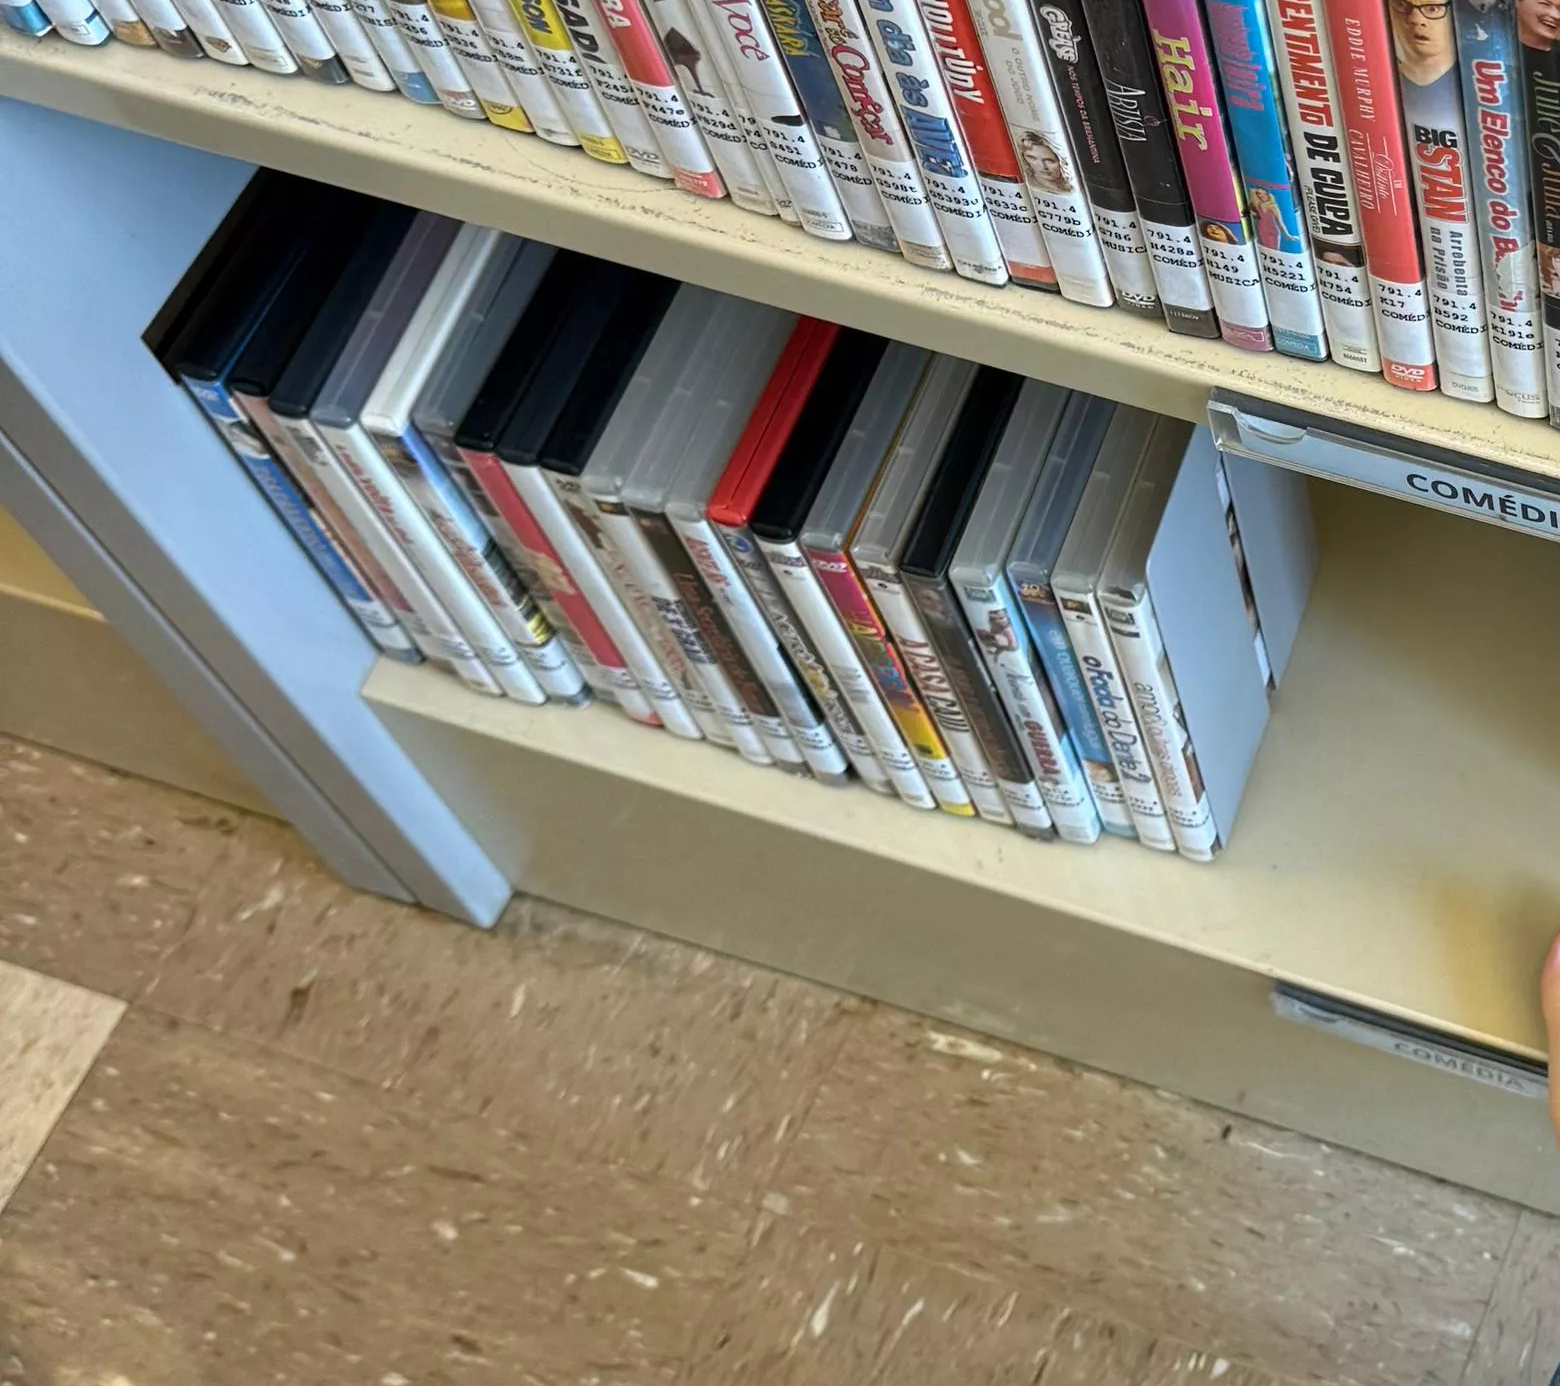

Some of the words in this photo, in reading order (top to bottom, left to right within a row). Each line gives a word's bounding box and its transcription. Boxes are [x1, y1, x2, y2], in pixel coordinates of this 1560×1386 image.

[1344, 17, 1366, 62] EDDIE
[1150, 27, 1214, 152] Hair
[1354, 66, 1376, 123] MURPHY
[1472, 59, 1504, 106] Um
[1304, 131, 1340, 164] DE
[1413, 124, 1458, 149] BIG
[1480, 111, 1511, 196] Elenco
[1348, 128, 1374, 210] CAVALHEIRO
[1416, 143, 1469, 223] STAN
[1310, 168, 1354, 237] CULPA
[1488, 199, 1519, 232] do
[1430, 226, 1442, 243] na
[1435, 245, 1449, 291] Prisão
[1449, 230, 1469, 297] Arrebenta
[1377, 283, 1423, 297] 791.4
[1379, 296, 1405, 309] K17
[1432, 294, 1477, 310] 791.4
